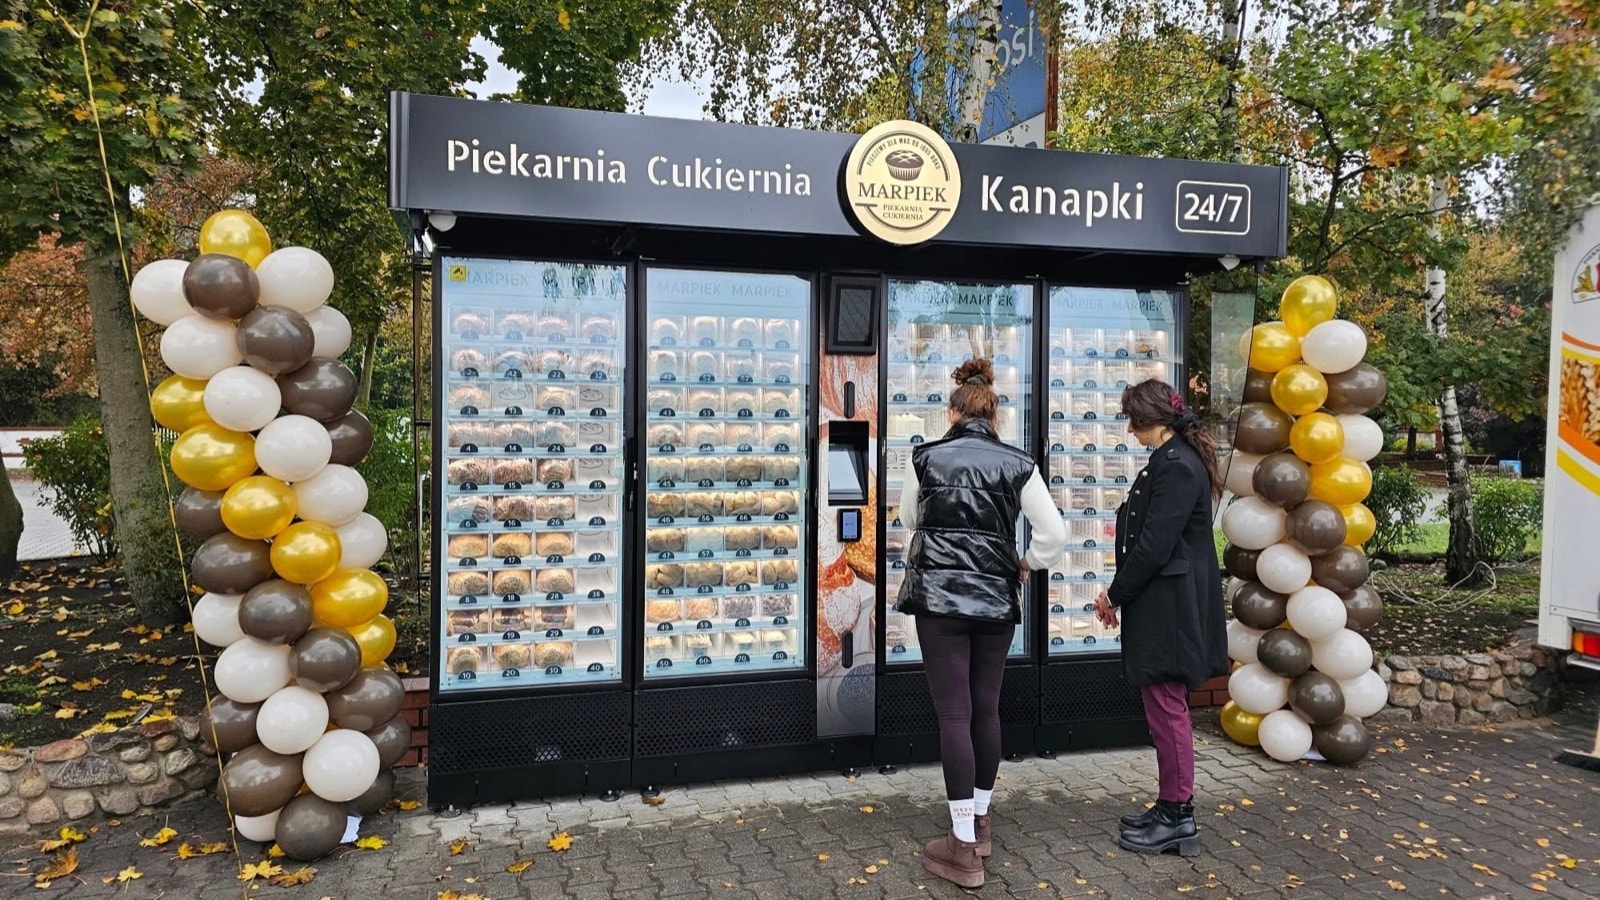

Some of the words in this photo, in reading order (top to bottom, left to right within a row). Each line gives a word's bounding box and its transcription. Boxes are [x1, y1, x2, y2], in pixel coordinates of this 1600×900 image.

[446, 139, 626, 184] Piekarnia
[647, 155, 812, 196] Cukiernia
[858, 182, 948, 202] MARPIEK
[982, 174, 1143, 227] Kanapki
[883, 204, 923, 213] PIEKARNIA
[1184, 192, 1243, 222] 24/7
[883, 213, 924, 221] CUKIERNIA
[467, 271, 530, 287] ARPIEK
[657, 280, 721, 296] MARPIEK
[732, 284, 792, 298] MARPIEK
